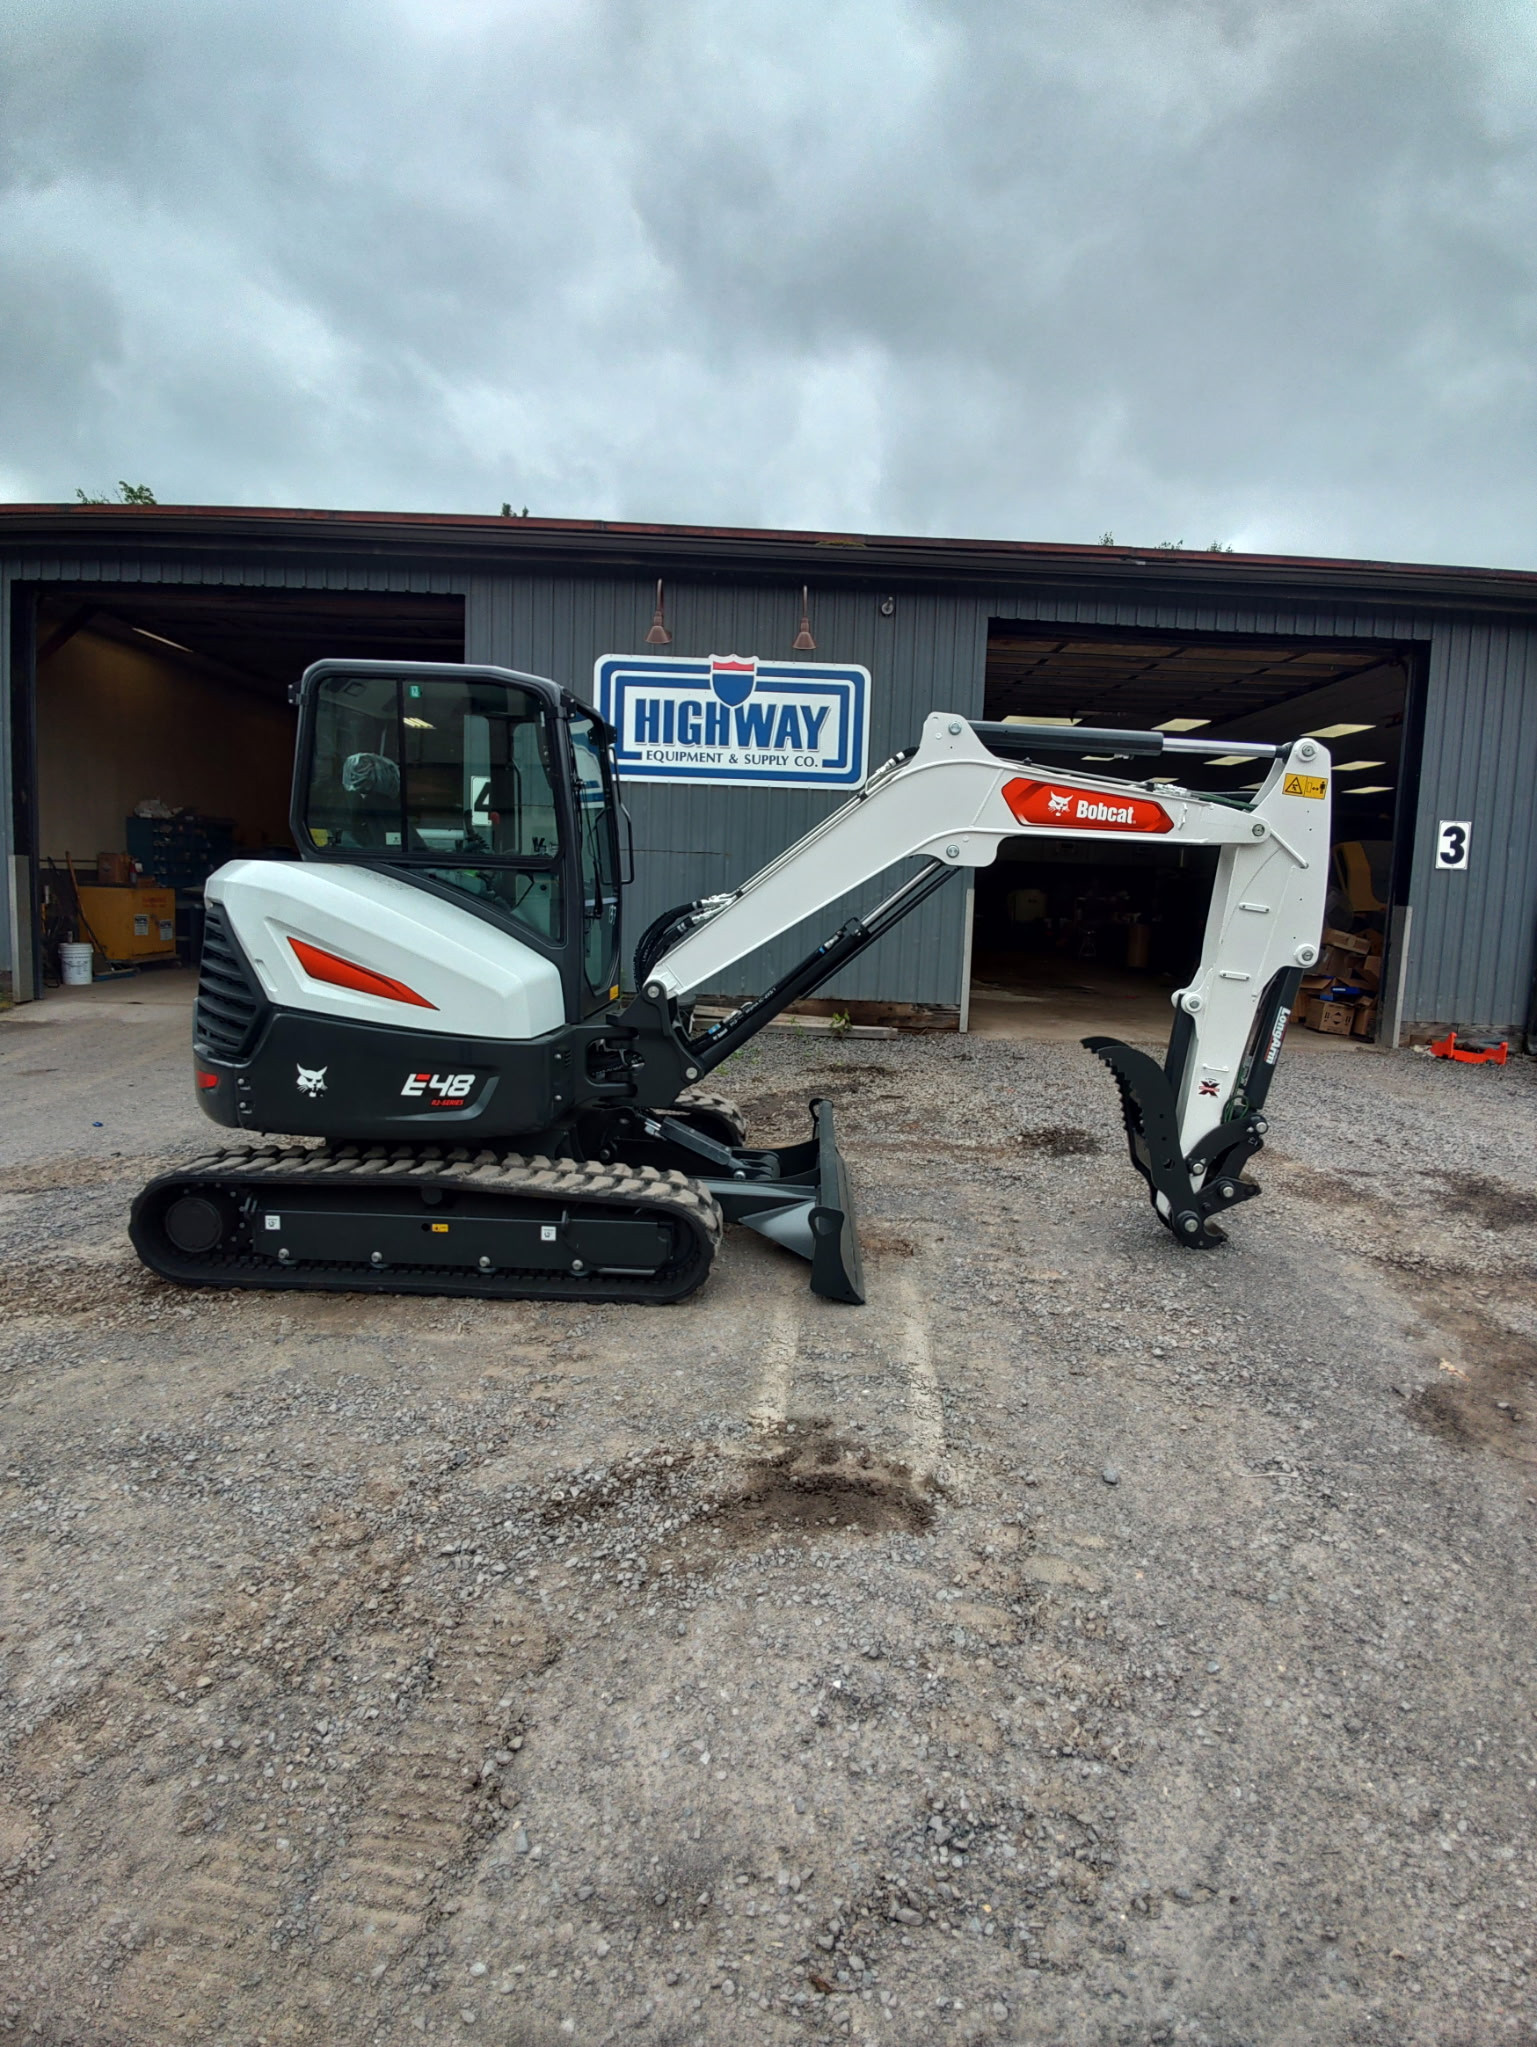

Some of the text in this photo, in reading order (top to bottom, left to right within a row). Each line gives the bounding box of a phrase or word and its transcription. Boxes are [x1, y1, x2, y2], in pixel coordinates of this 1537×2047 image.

[634, 698, 831, 752] HIGHWAY
[646, 750, 819, 768] EQUIPMENT & SUPPLY CO.
[1076, 800, 1134, 824] Bobcat
[1440, 825, 1466, 865] 3
[400, 1073, 476, 1096] E48
